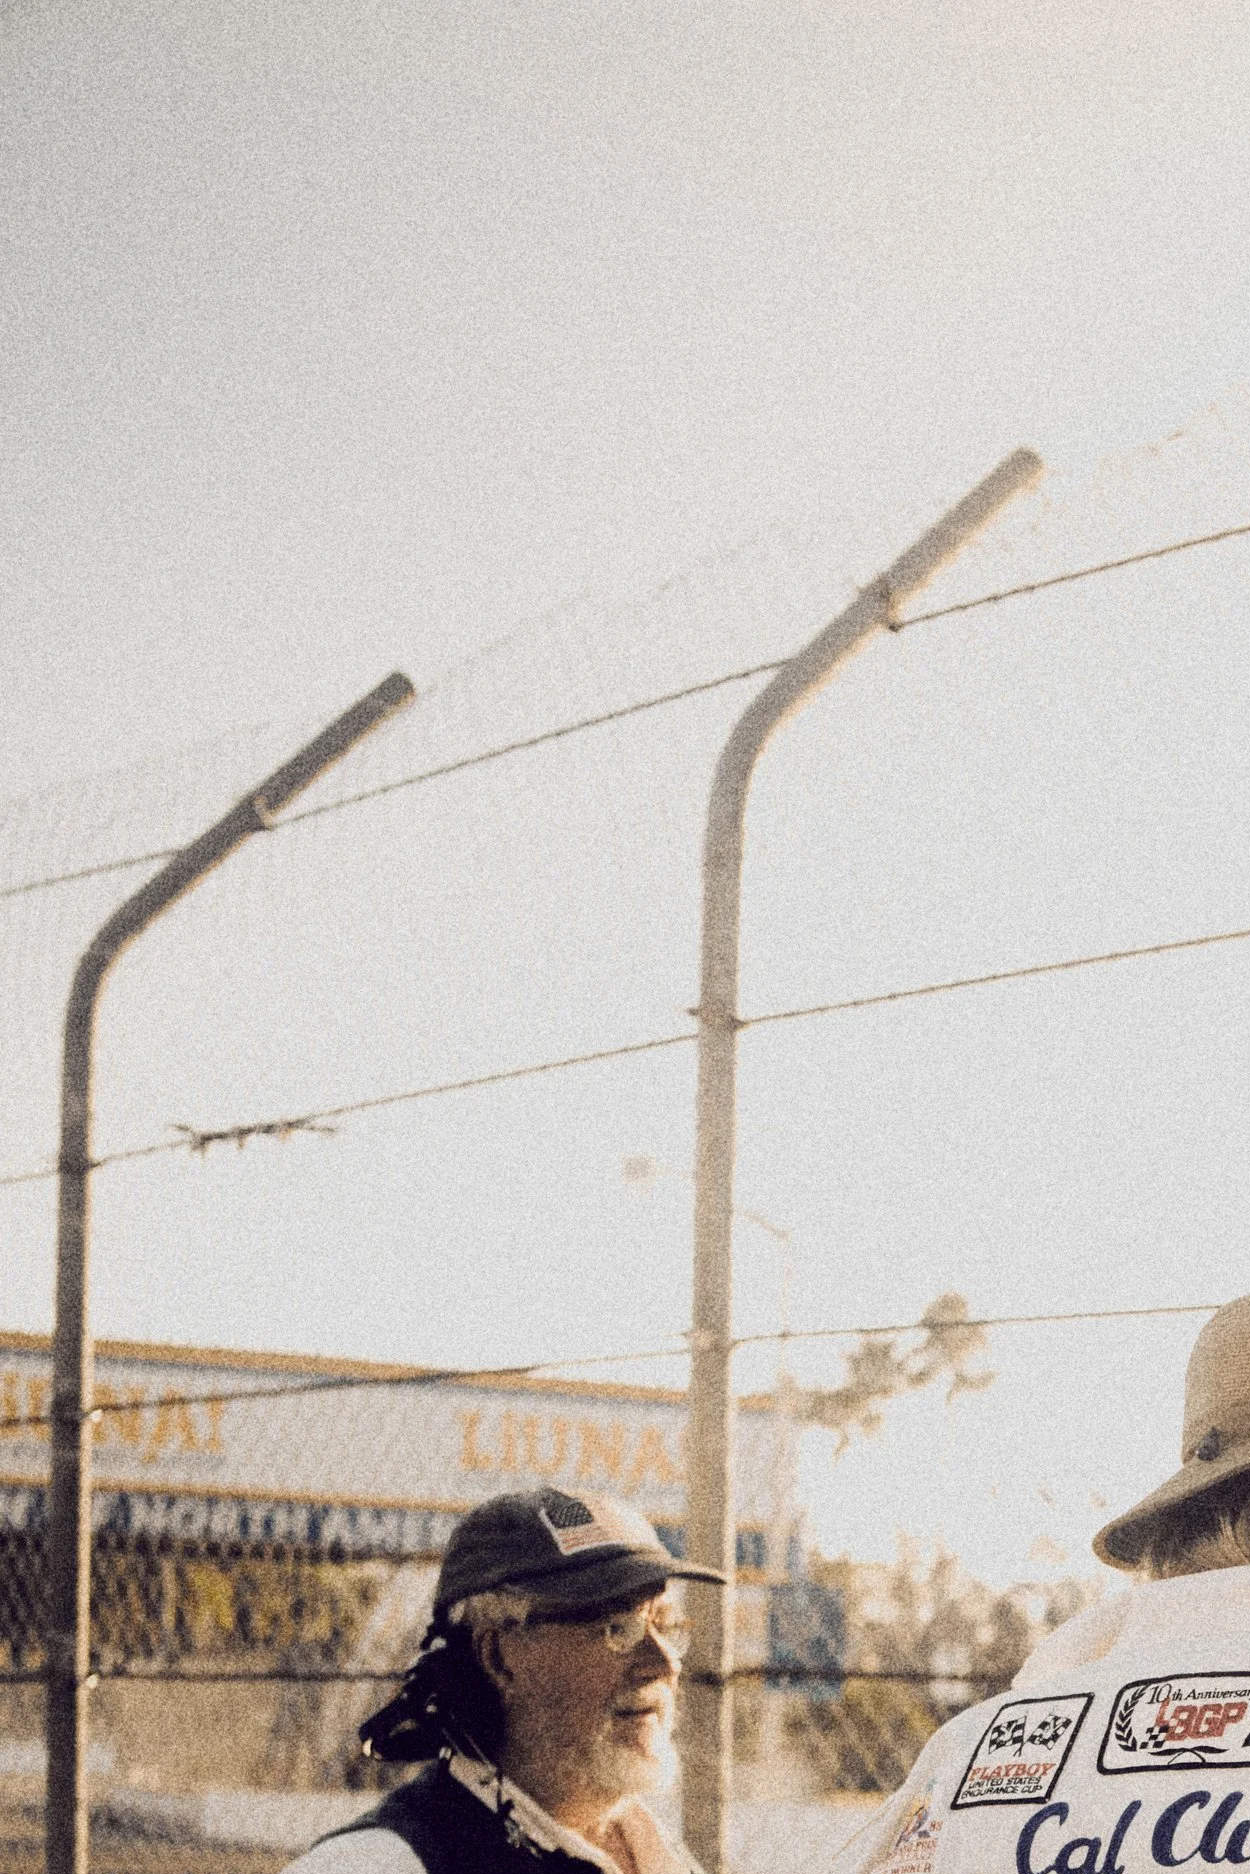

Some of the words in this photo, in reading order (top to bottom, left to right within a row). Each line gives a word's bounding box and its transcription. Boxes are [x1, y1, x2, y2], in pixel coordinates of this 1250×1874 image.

[968, 1763, 1056, 1782] PLAYBOY
[968, 1776, 1003, 1789] UNITED
[1006, 1776, 1041, 1786] STATES
[1021, 1785, 1043, 1793] CUP
